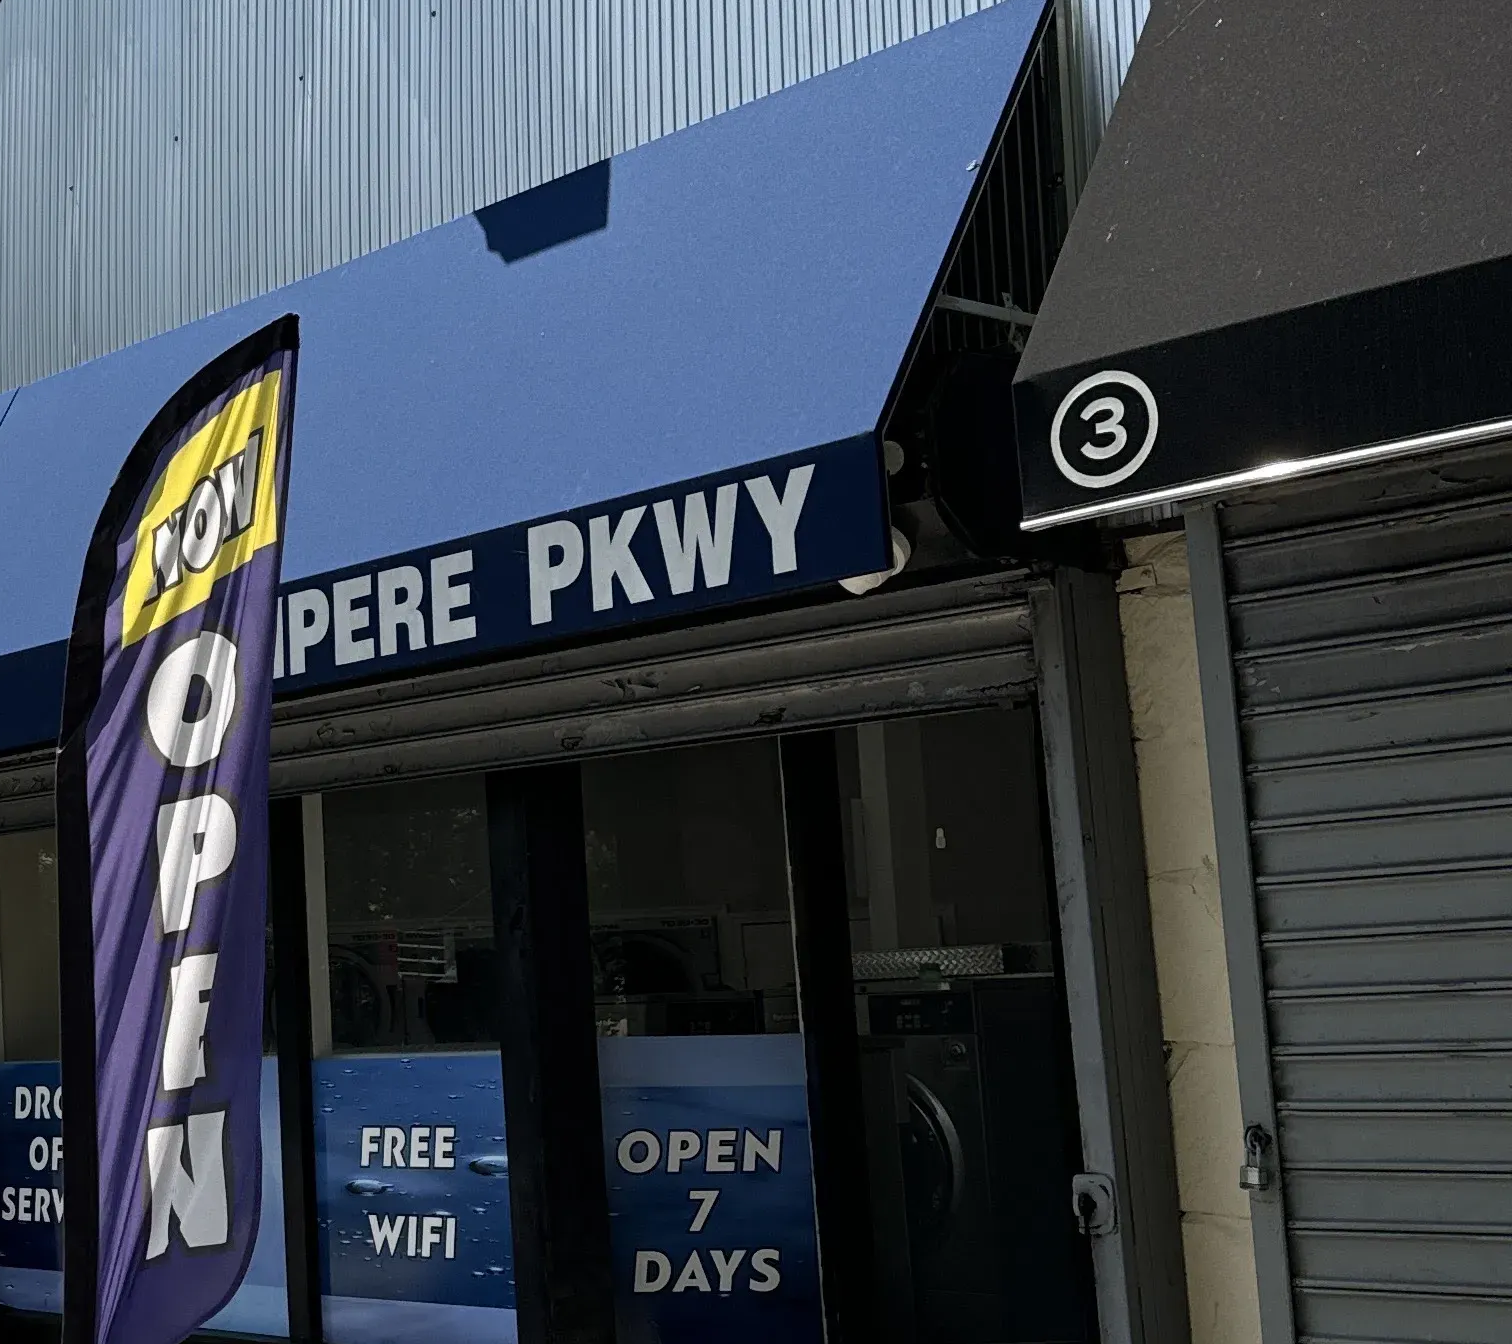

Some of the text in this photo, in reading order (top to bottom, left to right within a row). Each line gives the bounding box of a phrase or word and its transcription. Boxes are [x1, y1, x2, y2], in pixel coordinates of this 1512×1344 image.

[1079, 396, 1128, 460] 3
[142, 427, 263, 609] NOW
[527, 463, 816, 626] PKWY
[145, 630, 238, 1260] OPEN
[360, 1126, 455, 1168] FREE
[617, 1129, 782, 1174] OPEN
[689, 1190, 720, 1232] 7
[368, 1214, 456, 1259] WIFI
[633, 1248, 781, 1293] DAYS
